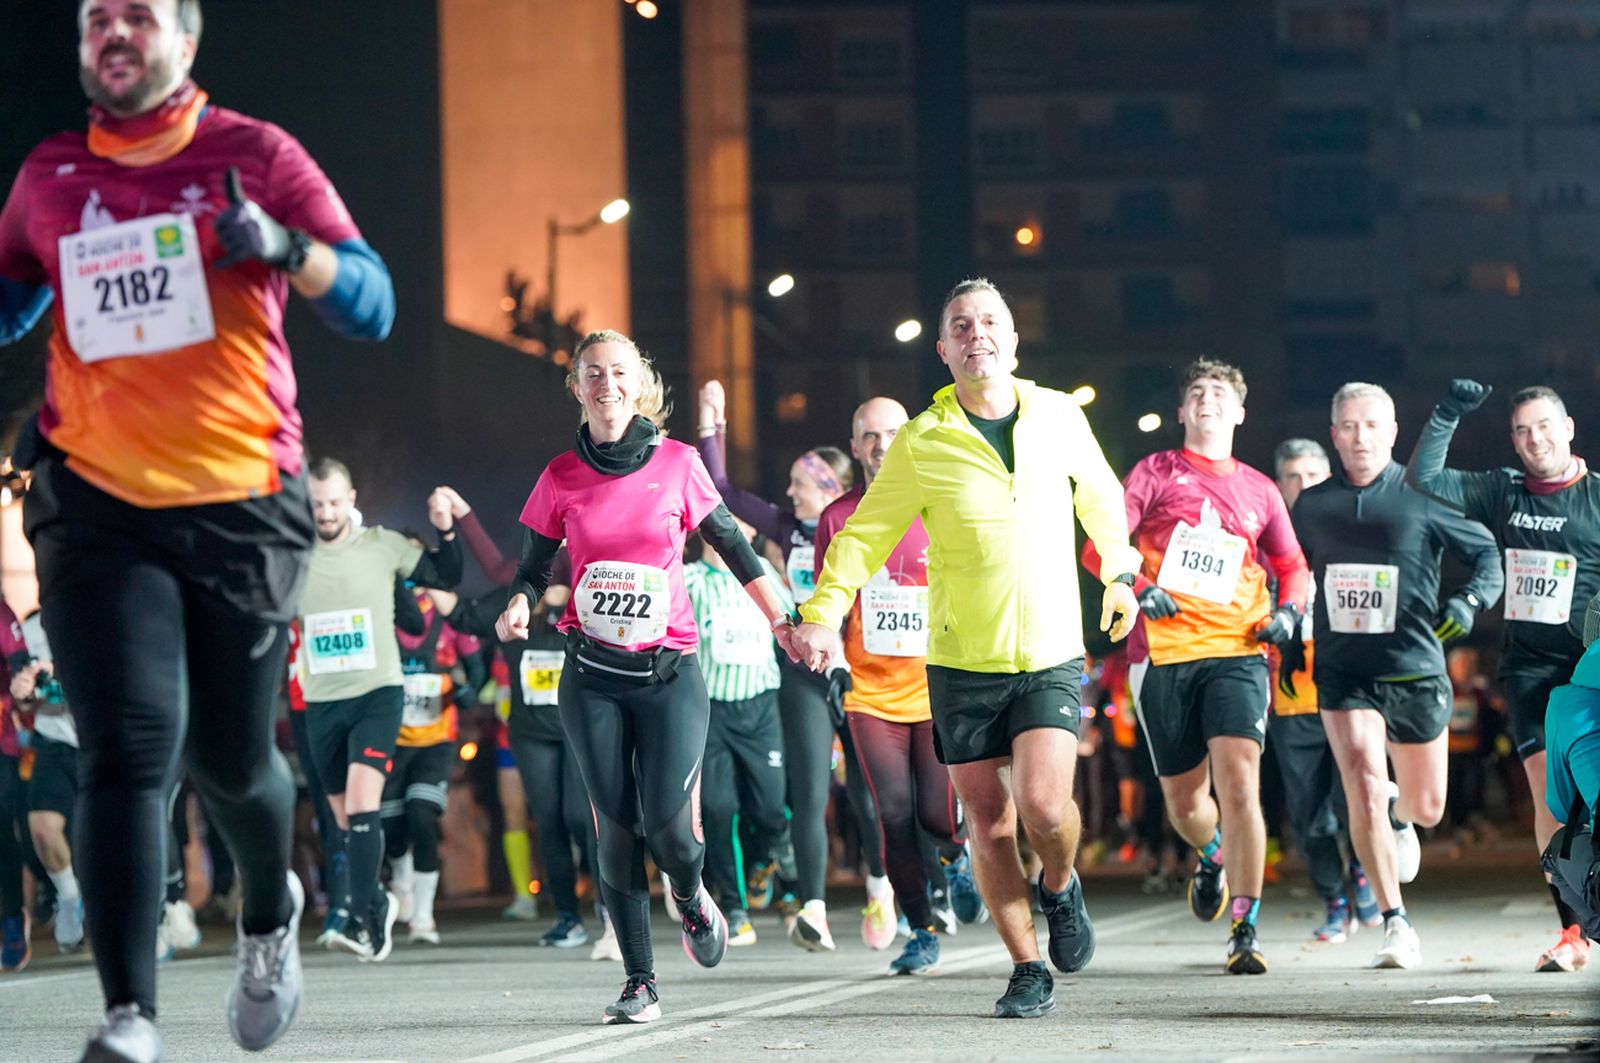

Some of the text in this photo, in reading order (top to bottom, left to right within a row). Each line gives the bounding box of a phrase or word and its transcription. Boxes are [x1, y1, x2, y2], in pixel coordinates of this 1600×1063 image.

[93, 265, 174, 314] 2182
[1181, 549, 1224, 576] 1394
[588, 581, 602, 590] SAN
[625, 572, 636, 580] DE
[1515, 576, 1558, 598] 2092
[592, 591, 651, 618] 2222
[1336, 589, 1382, 609] 5620
[610, 617, 632, 625] Cristina
[876, 611, 922, 631] 2345
[315, 632, 364, 653] 12408
